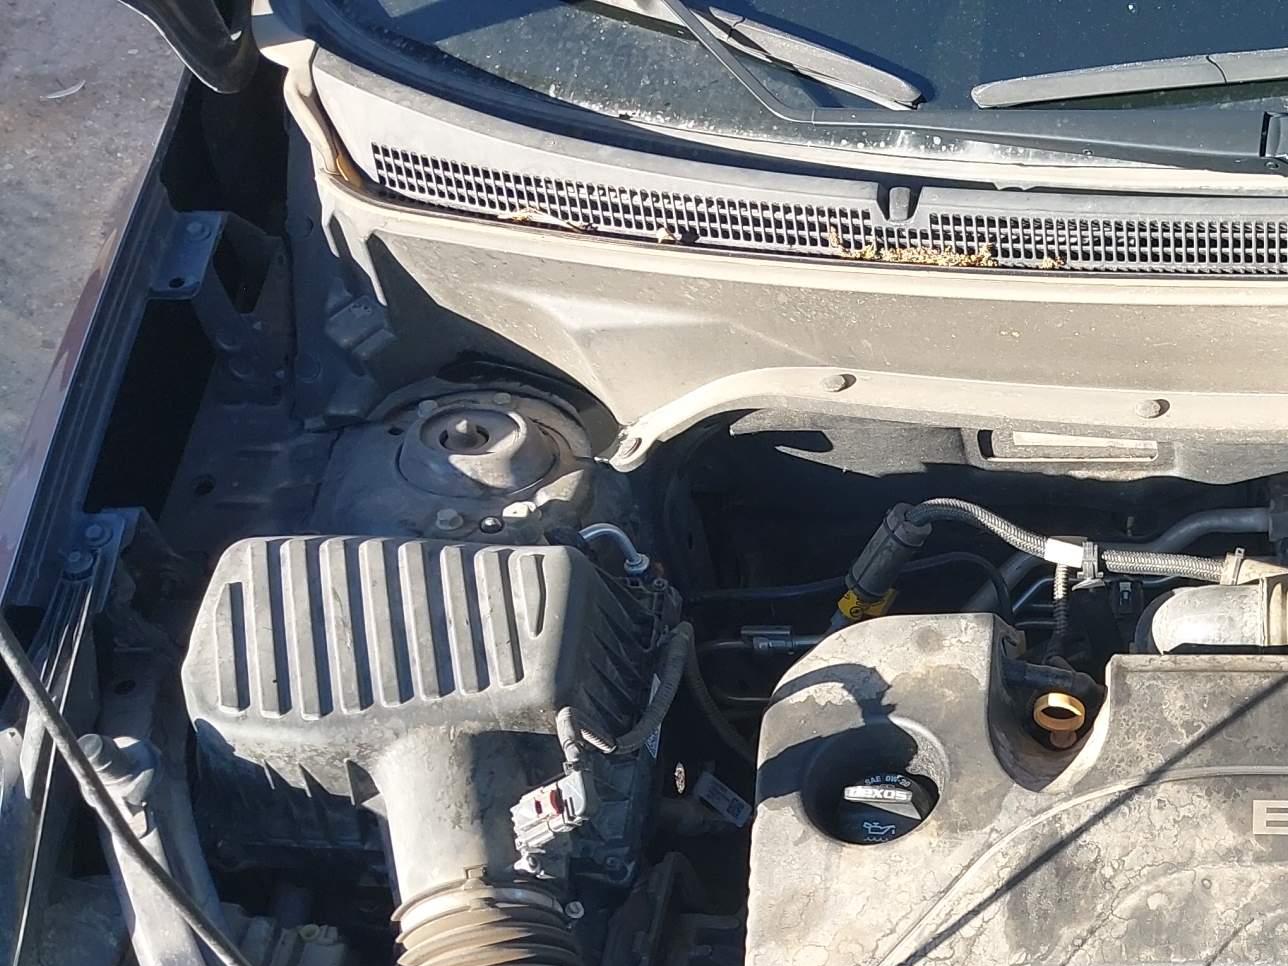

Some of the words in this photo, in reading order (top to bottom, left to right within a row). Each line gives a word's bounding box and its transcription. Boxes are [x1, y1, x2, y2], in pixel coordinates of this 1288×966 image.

[864, 775, 882, 786] SAE
[885, 774, 911, 787] 0W-20
[847, 786, 908, 801] dexos
